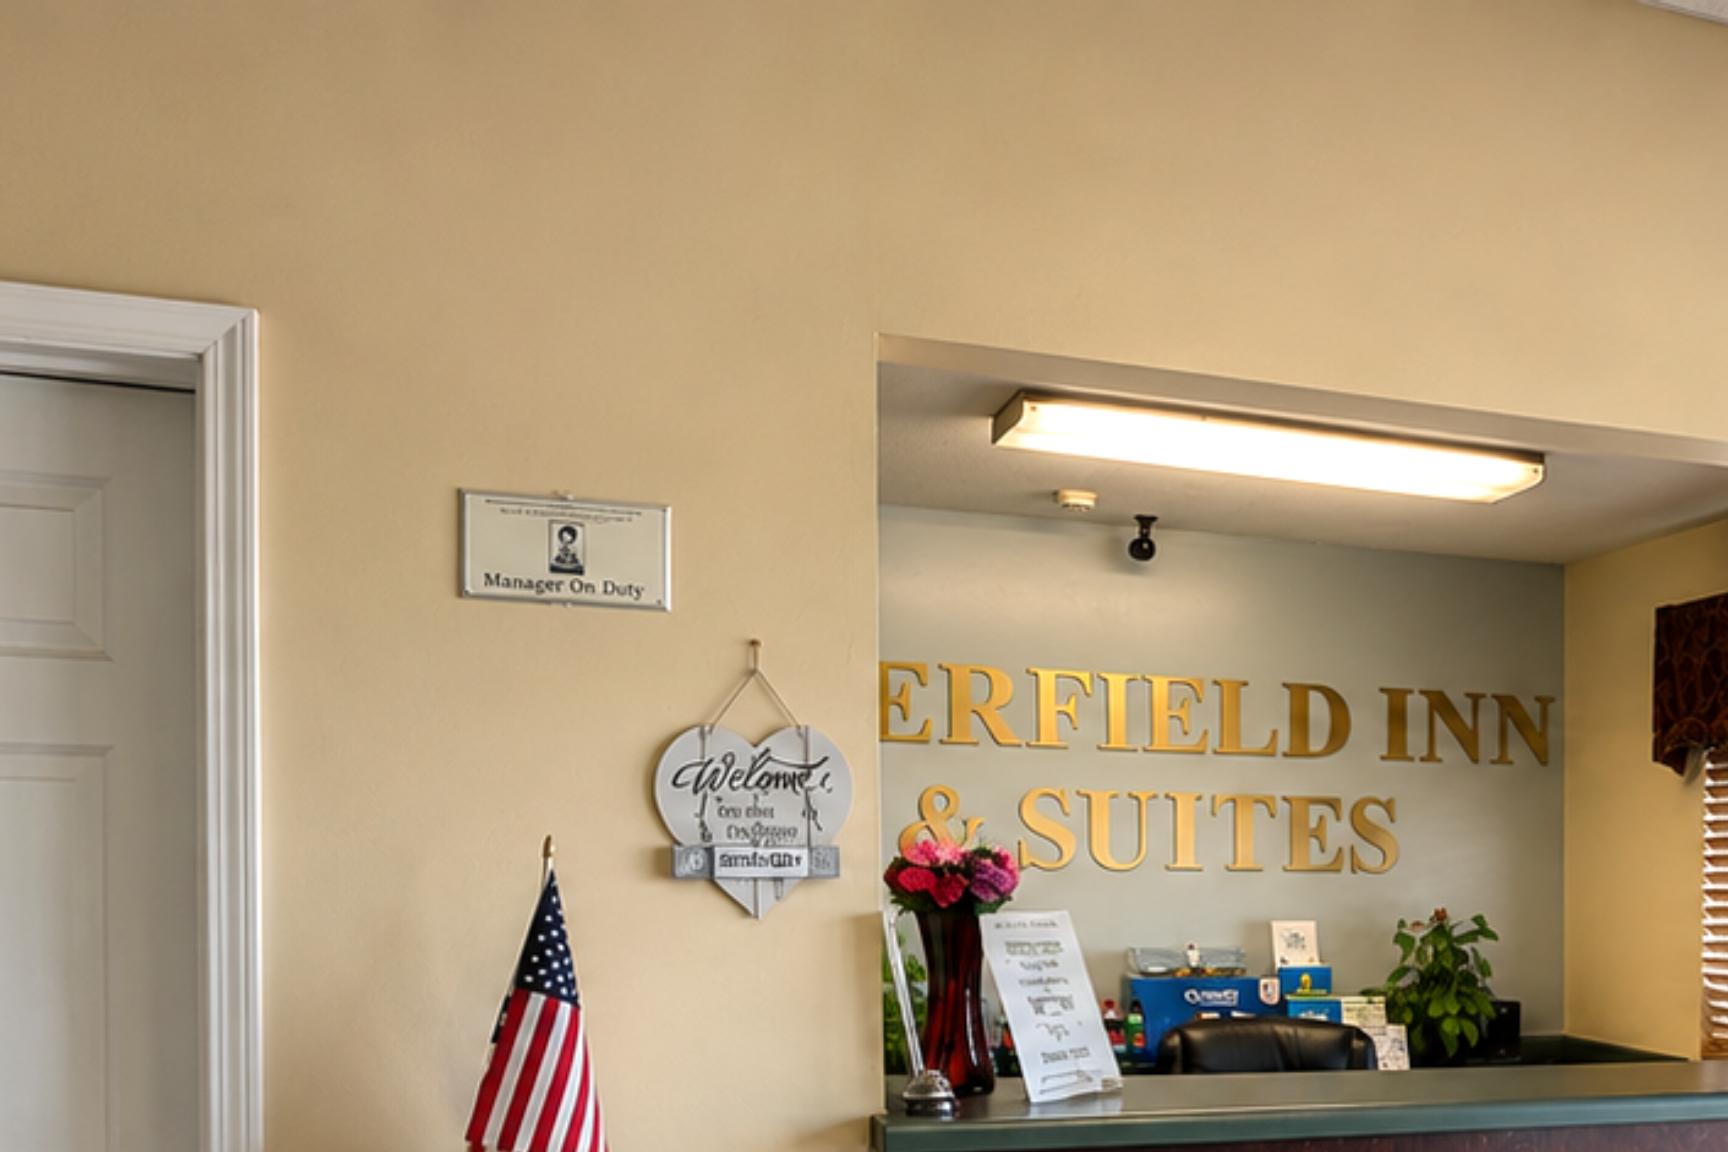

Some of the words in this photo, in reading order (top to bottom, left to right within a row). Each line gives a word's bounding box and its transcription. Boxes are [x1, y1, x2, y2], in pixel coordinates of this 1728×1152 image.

[484, 572, 565, 595] Manager
[570, 578, 596, 594] On
[603, 580, 645, 600] Duty
[1378, 687, 1556, 766] INN
[898, 784, 984, 867] &
[1018, 787, 1400, 875] SUITES
